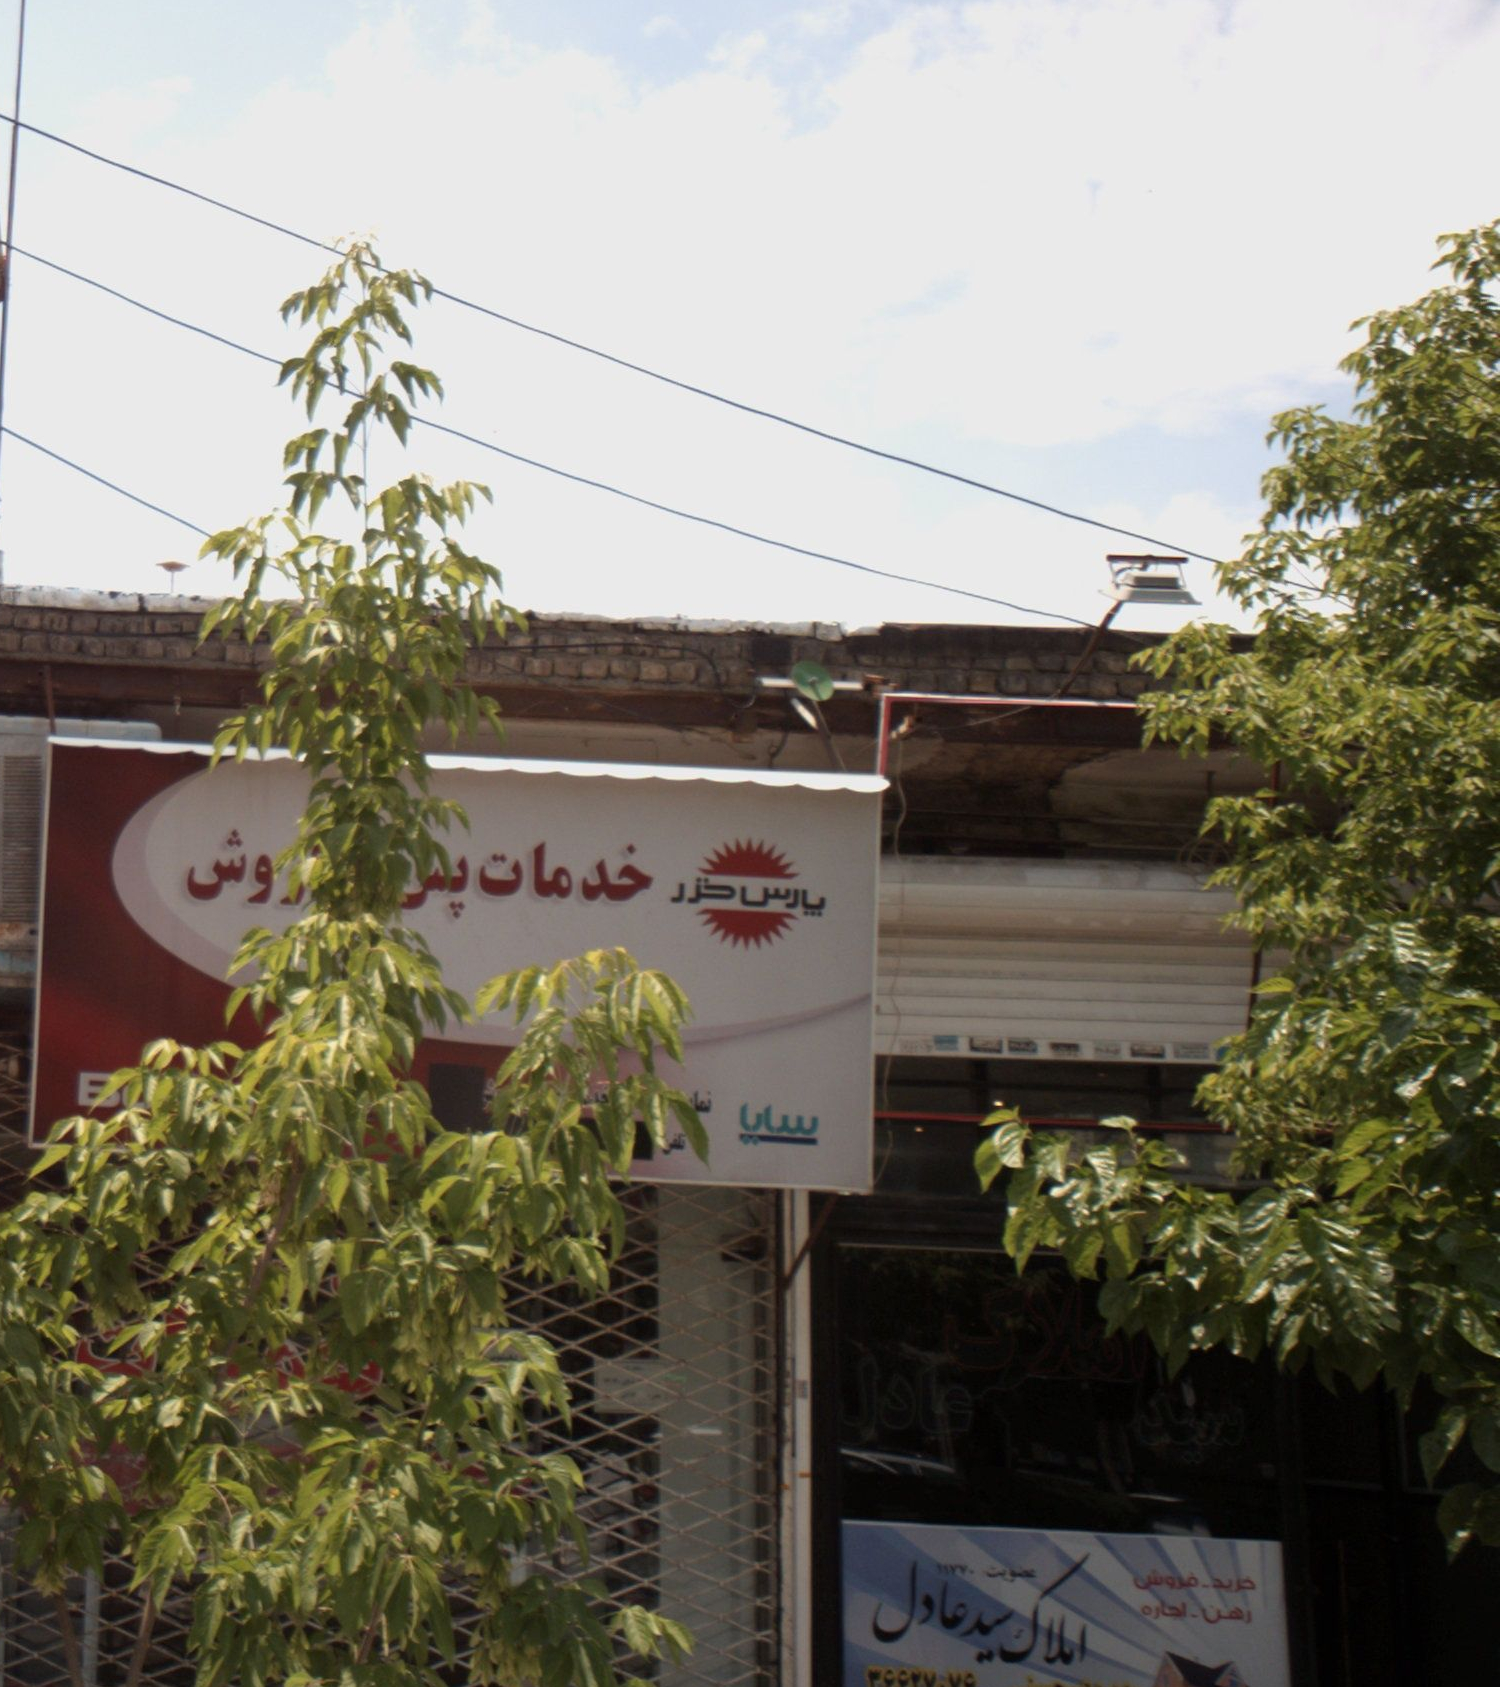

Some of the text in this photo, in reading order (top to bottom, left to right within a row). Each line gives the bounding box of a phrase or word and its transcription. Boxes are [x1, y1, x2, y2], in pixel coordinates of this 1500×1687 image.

[479, 843, 652, 903] خدمات
[671, 877, 828, 917] پارس خزر
